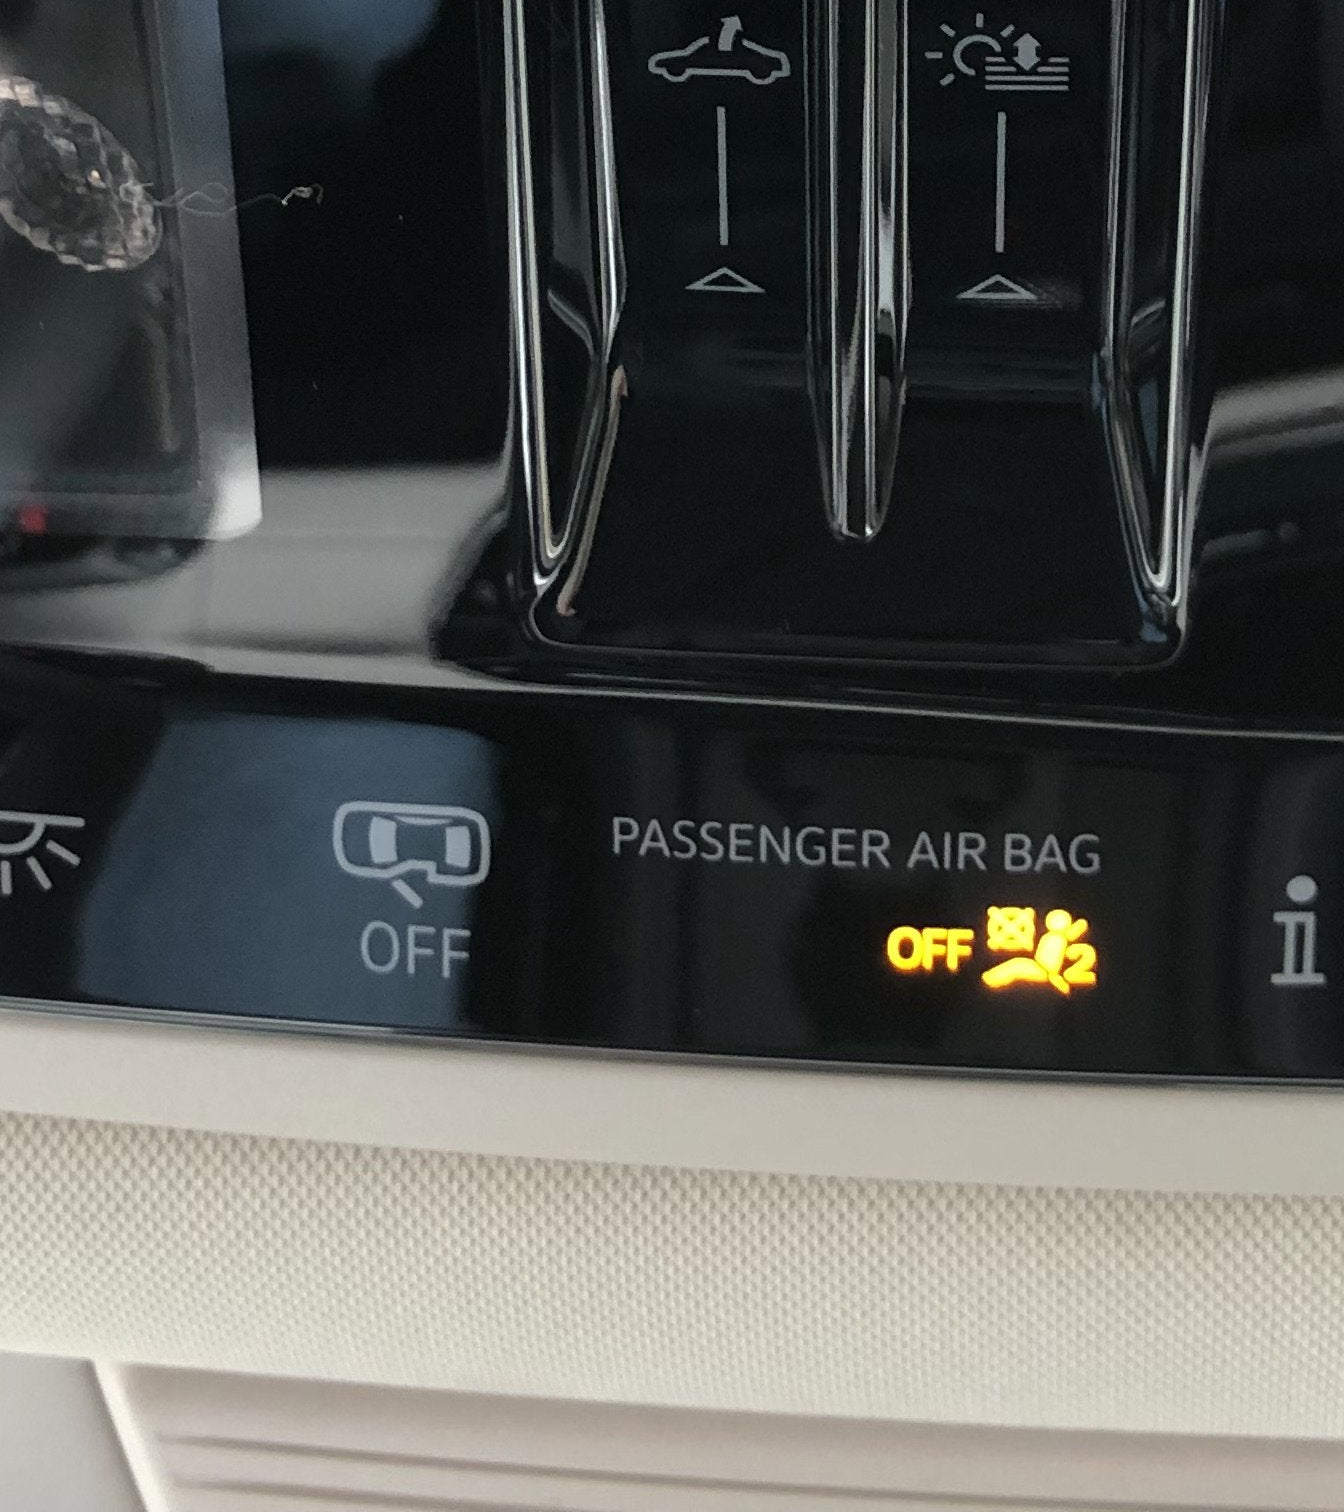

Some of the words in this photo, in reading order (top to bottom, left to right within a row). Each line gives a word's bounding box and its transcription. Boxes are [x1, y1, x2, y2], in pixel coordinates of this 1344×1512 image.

[611, 816, 892, 870] PASSENGER
[906, 831, 987, 871] AIR
[1003, 833, 1101, 875] BAG
[360, 920, 472, 978] OFF
[886, 925, 975, 972] OFF
